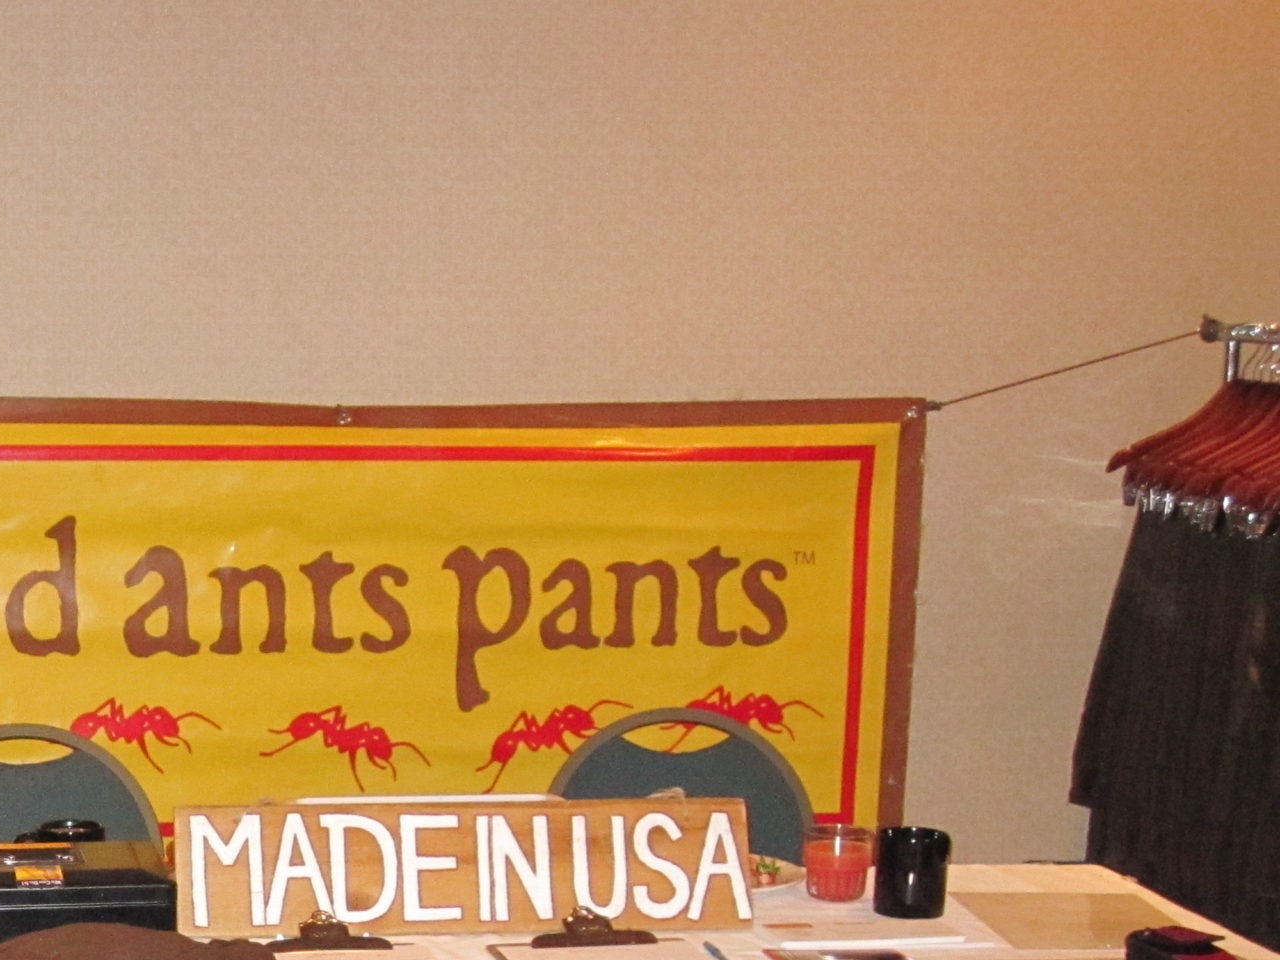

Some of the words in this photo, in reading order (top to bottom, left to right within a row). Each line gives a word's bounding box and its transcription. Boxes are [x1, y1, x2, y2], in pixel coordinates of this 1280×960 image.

[123, 545, 411, 657] ants
[441, 545, 788, 712] pants
[189, 812, 463, 927] MADE
[476, 814, 555, 922] IN
[570, 812, 753, 921] USA
